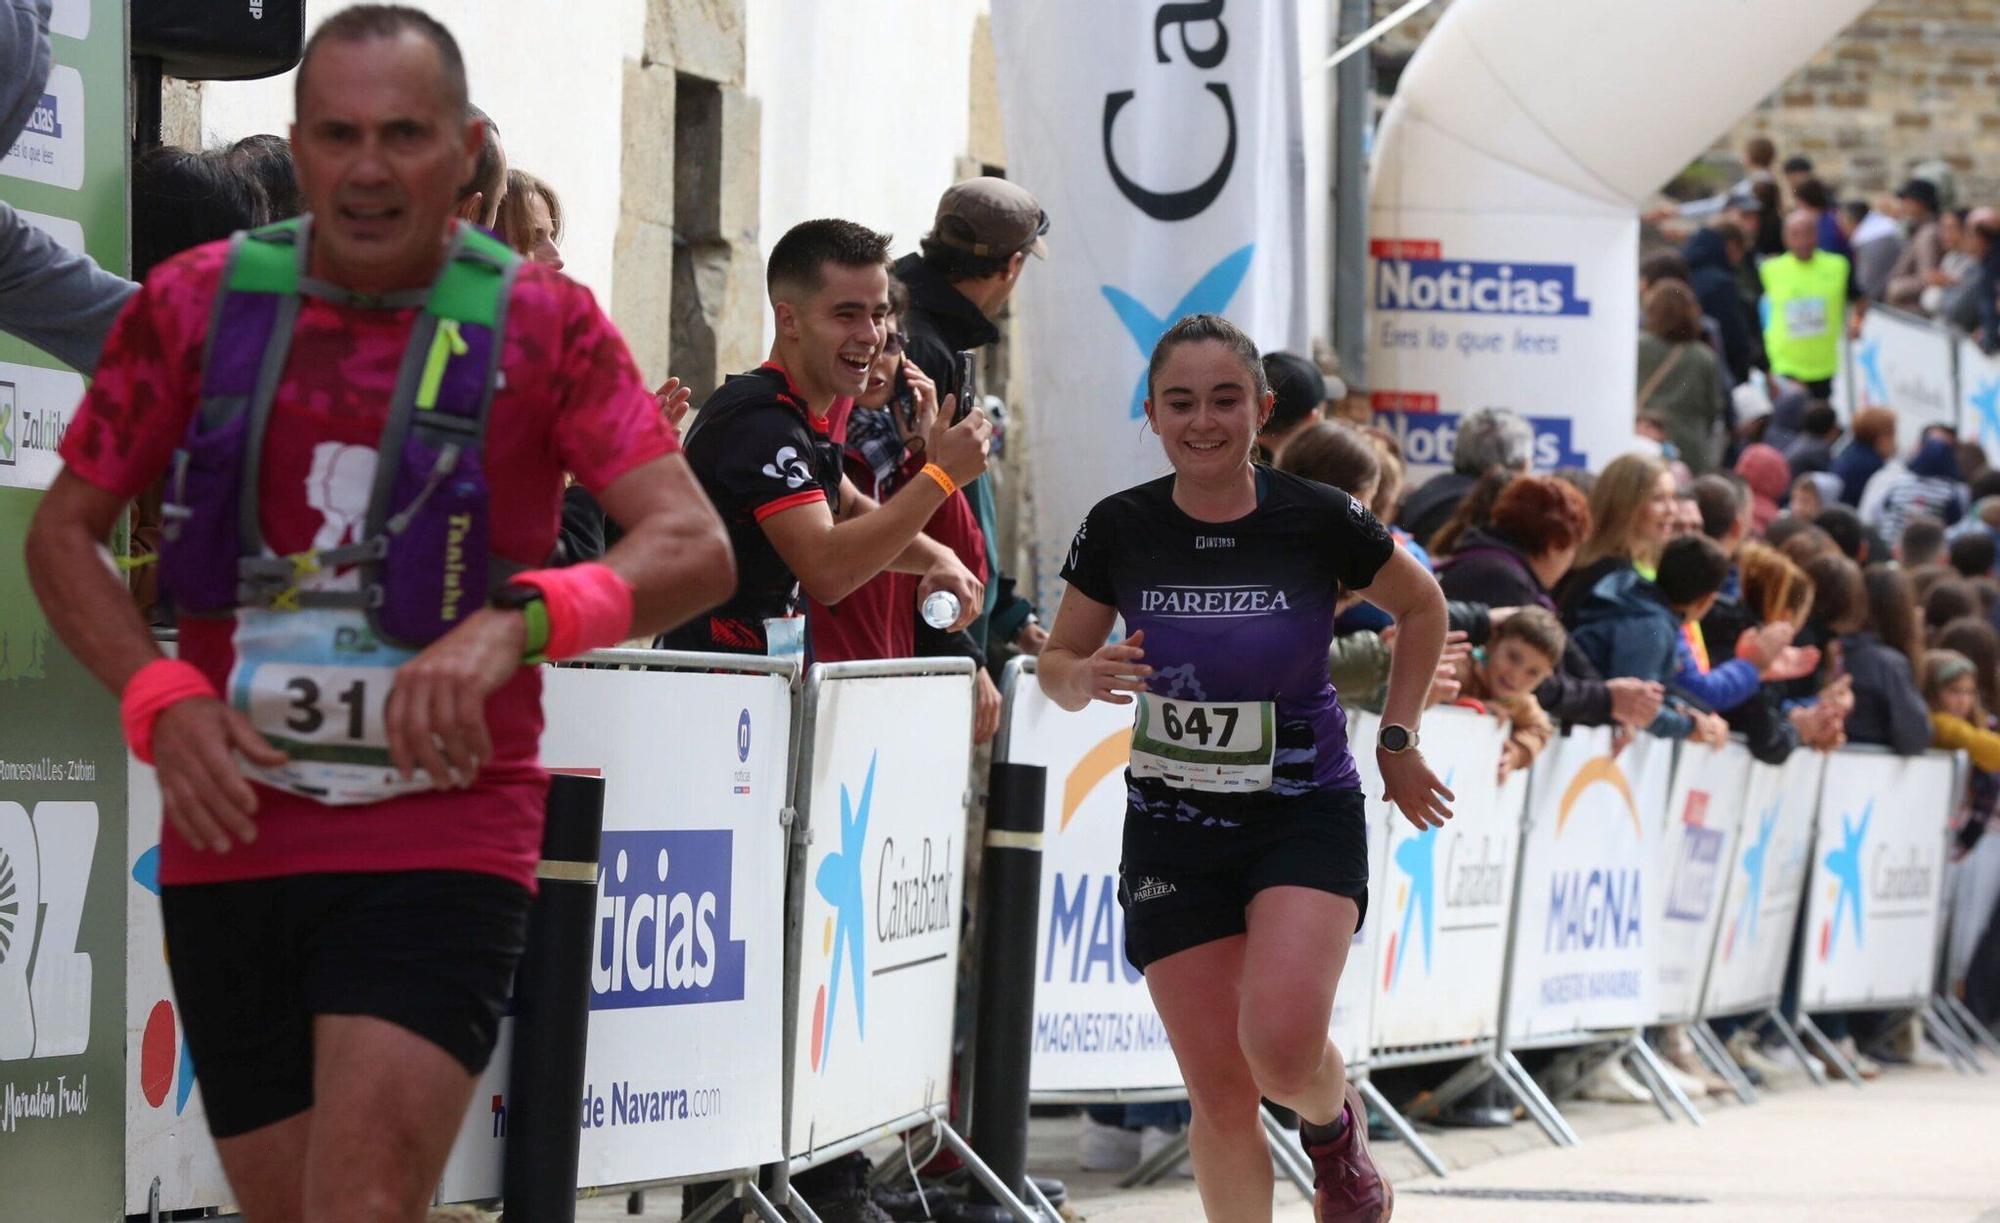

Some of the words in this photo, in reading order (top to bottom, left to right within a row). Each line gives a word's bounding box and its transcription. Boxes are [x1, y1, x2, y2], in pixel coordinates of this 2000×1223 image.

[1379, 262, 1564, 315] Noticias
[1427, 326, 1448, 350] lo
[1457, 331, 1502, 358] que
[1141, 590, 1291, 613] IPAREIZEA
[286, 676, 367, 740] 31
[1162, 702, 1239, 748] 647
[877, 836, 952, 943] CaixaBank
[1543, 869, 1642, 954] MAGNA
[591, 848, 716, 994] ticias
[1043, 873, 1142, 985] MA
[1034, 1012, 1135, 1052] MAGNESITAS
[57, 1074, 89, 1118] Trail
[581, 1084, 604, 1129] de
[611, 1081, 721, 1126] Navarra.com
